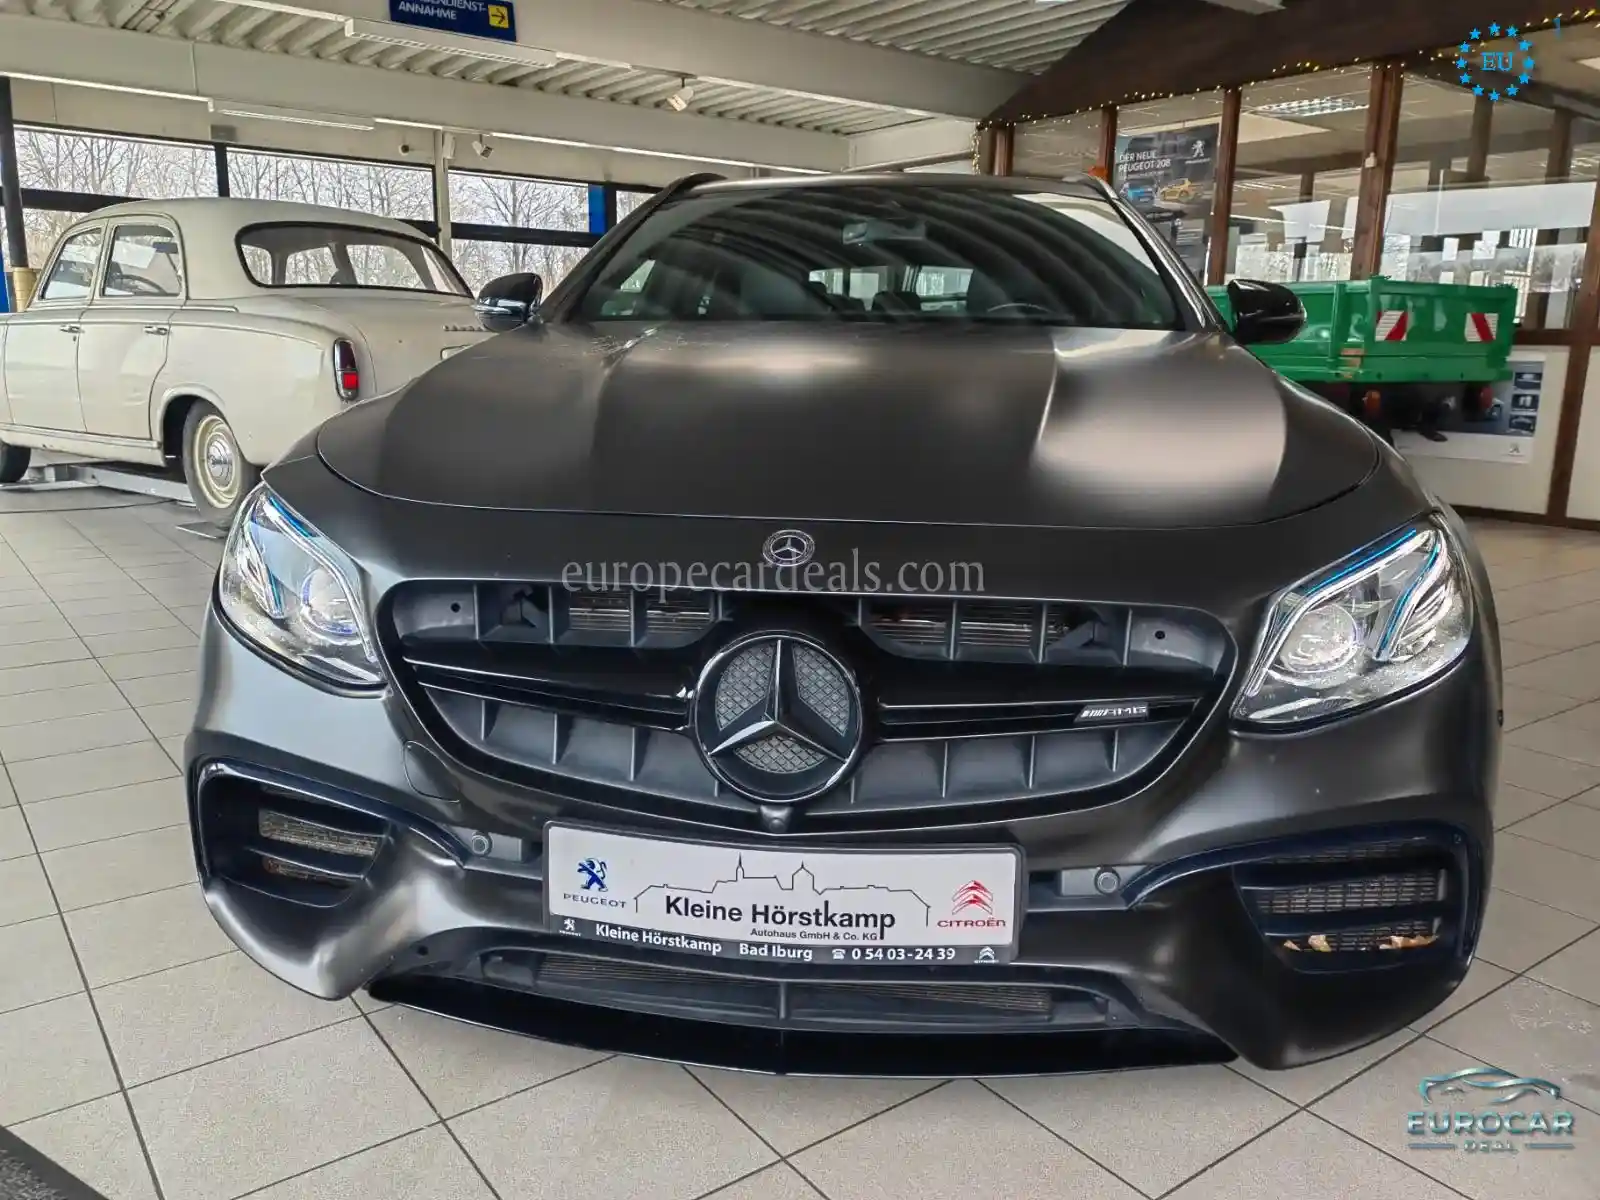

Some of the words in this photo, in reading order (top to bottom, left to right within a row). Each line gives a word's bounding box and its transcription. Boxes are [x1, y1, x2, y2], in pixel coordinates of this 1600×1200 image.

[398, 1, 457, 20] ANNAHME
[1119, 151, 1135, 162] DER
[1118, 160, 1154, 173] PEUGEOT
[1156, 157, 1171, 169] 208
[563, 892, 627, 909] PEUGEOT
[665, 895, 743, 922] Kleine
[751, 899, 896, 941] Hörstkamp
[936, 917, 1007, 929] CITROËN
[750, 927, 797, 939] Autohaus
[799, 930, 831, 940] GmbH
[832, 931, 841, 941] &
[842, 932, 860, 941] Co.
[862, 932, 878, 941] KG
[595, 923, 640, 942] Kleine
[642, 931, 723, 956] Hörstkamp
[739, 942, 769, 957] Bad
[771, 944, 813, 962] Iburg
[851, 948, 861, 960] 0
[864, 948, 884, 960] 54
[936, 948, 956, 960] 39
